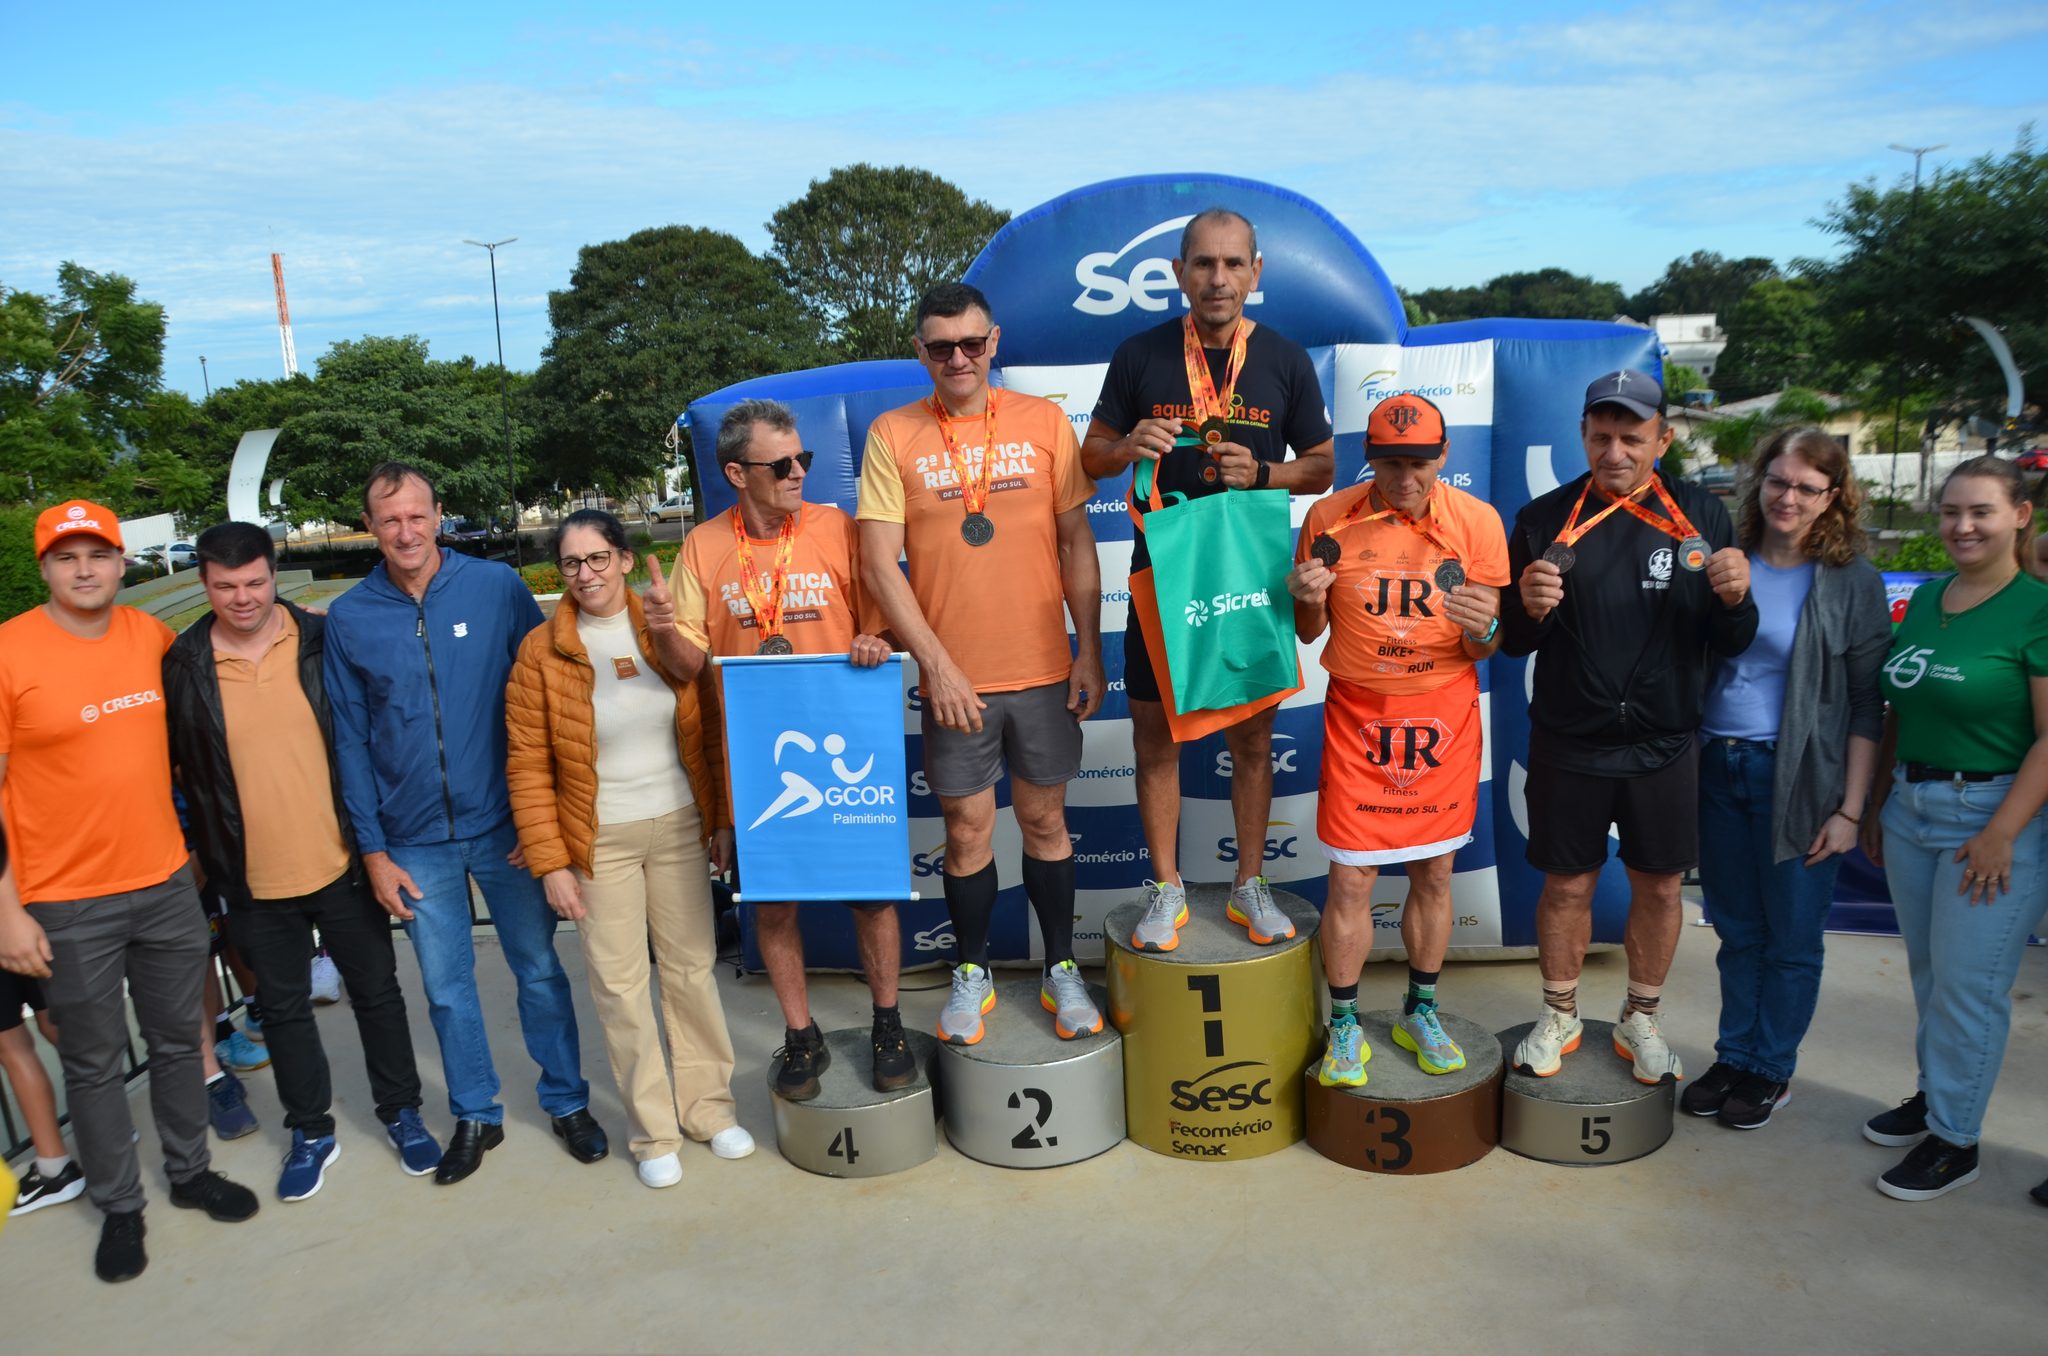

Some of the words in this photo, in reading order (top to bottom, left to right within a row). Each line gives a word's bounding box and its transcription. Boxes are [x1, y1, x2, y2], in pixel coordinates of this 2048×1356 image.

[1072, 251, 1265, 316] Se
[1456, 382, 1476, 396] RS
[1152, 403, 1246, 420] aquaon
[1249, 408, 1271, 423] sc
[943, 490, 952, 498] DE
[1009, 480, 1022, 488] SUL
[1453, 473, 1472, 486] RS
[1085, 500, 1128, 514] mércio
[56, 520, 102, 532] CRESOL
[760, 571, 833, 594] ÚTICA
[1100, 589, 1132, 603] ércio
[1365, 577, 1436, 618] JR
[1386, 636, 1416, 645] Fitness
[1378, 646, 1415, 657] BIKE+
[1407, 661, 1434, 673] RUN
[1883, 645, 1935, 689] 45
[102, 690, 160, 714] CRESOL
[1366, 726, 1442, 770] JR
[1073, 766, 1135, 779] omércio
[1215, 749, 1297, 777] Ssc
[824, 785, 895, 806] GCOR
[1383, 786, 1418, 796] Fitness
[1356, 803, 1402, 815] AMETISTA
[1406, 807, 1419, 815] DO
[1422, 804, 1438, 813] SUL
[833, 813, 896, 825] Palmitinho
[1073, 850, 1136, 863] omércio
[1139, 848, 1151, 860] R
[1216, 836, 1297, 862] Ssc
[1459, 916, 1478, 926] RS
[914, 931, 957, 950] Se
[1187, 974, 1224, 1057] 1
[1170, 1078, 1272, 1112] Sesc
[1008, 1088, 1058, 1148] 2
[1170, 1118, 1273, 1138] Fecomércio
[1580, 1116, 1611, 1155] 5
[828, 1127, 860, 1164] 4
[1172, 1140, 1227, 1156] Senac
[1365, 1107, 1413, 1170] 3
